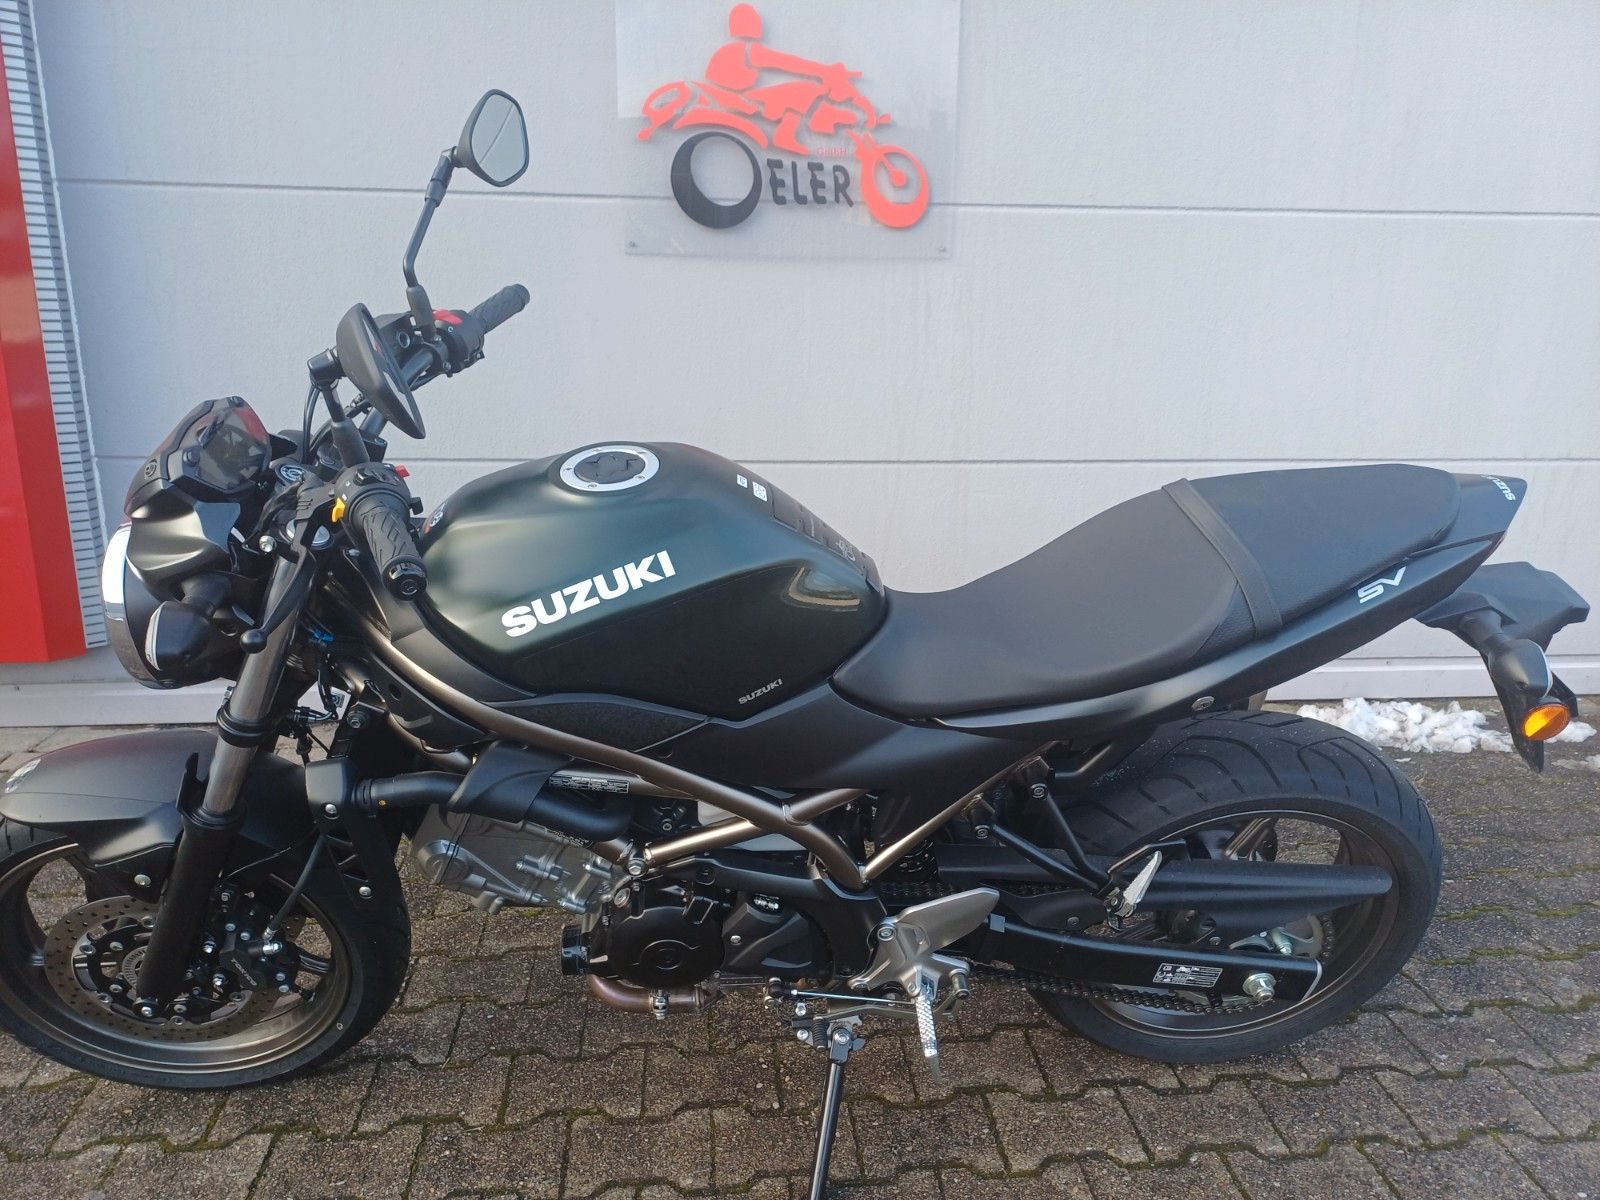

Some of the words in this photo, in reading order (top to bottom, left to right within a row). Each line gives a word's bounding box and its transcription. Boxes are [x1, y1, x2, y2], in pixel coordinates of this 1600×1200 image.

[501, 550, 676, 637] SUZUKI
[1357, 566, 1407, 603] SV
[738, 678, 783, 704] SUZUKI
